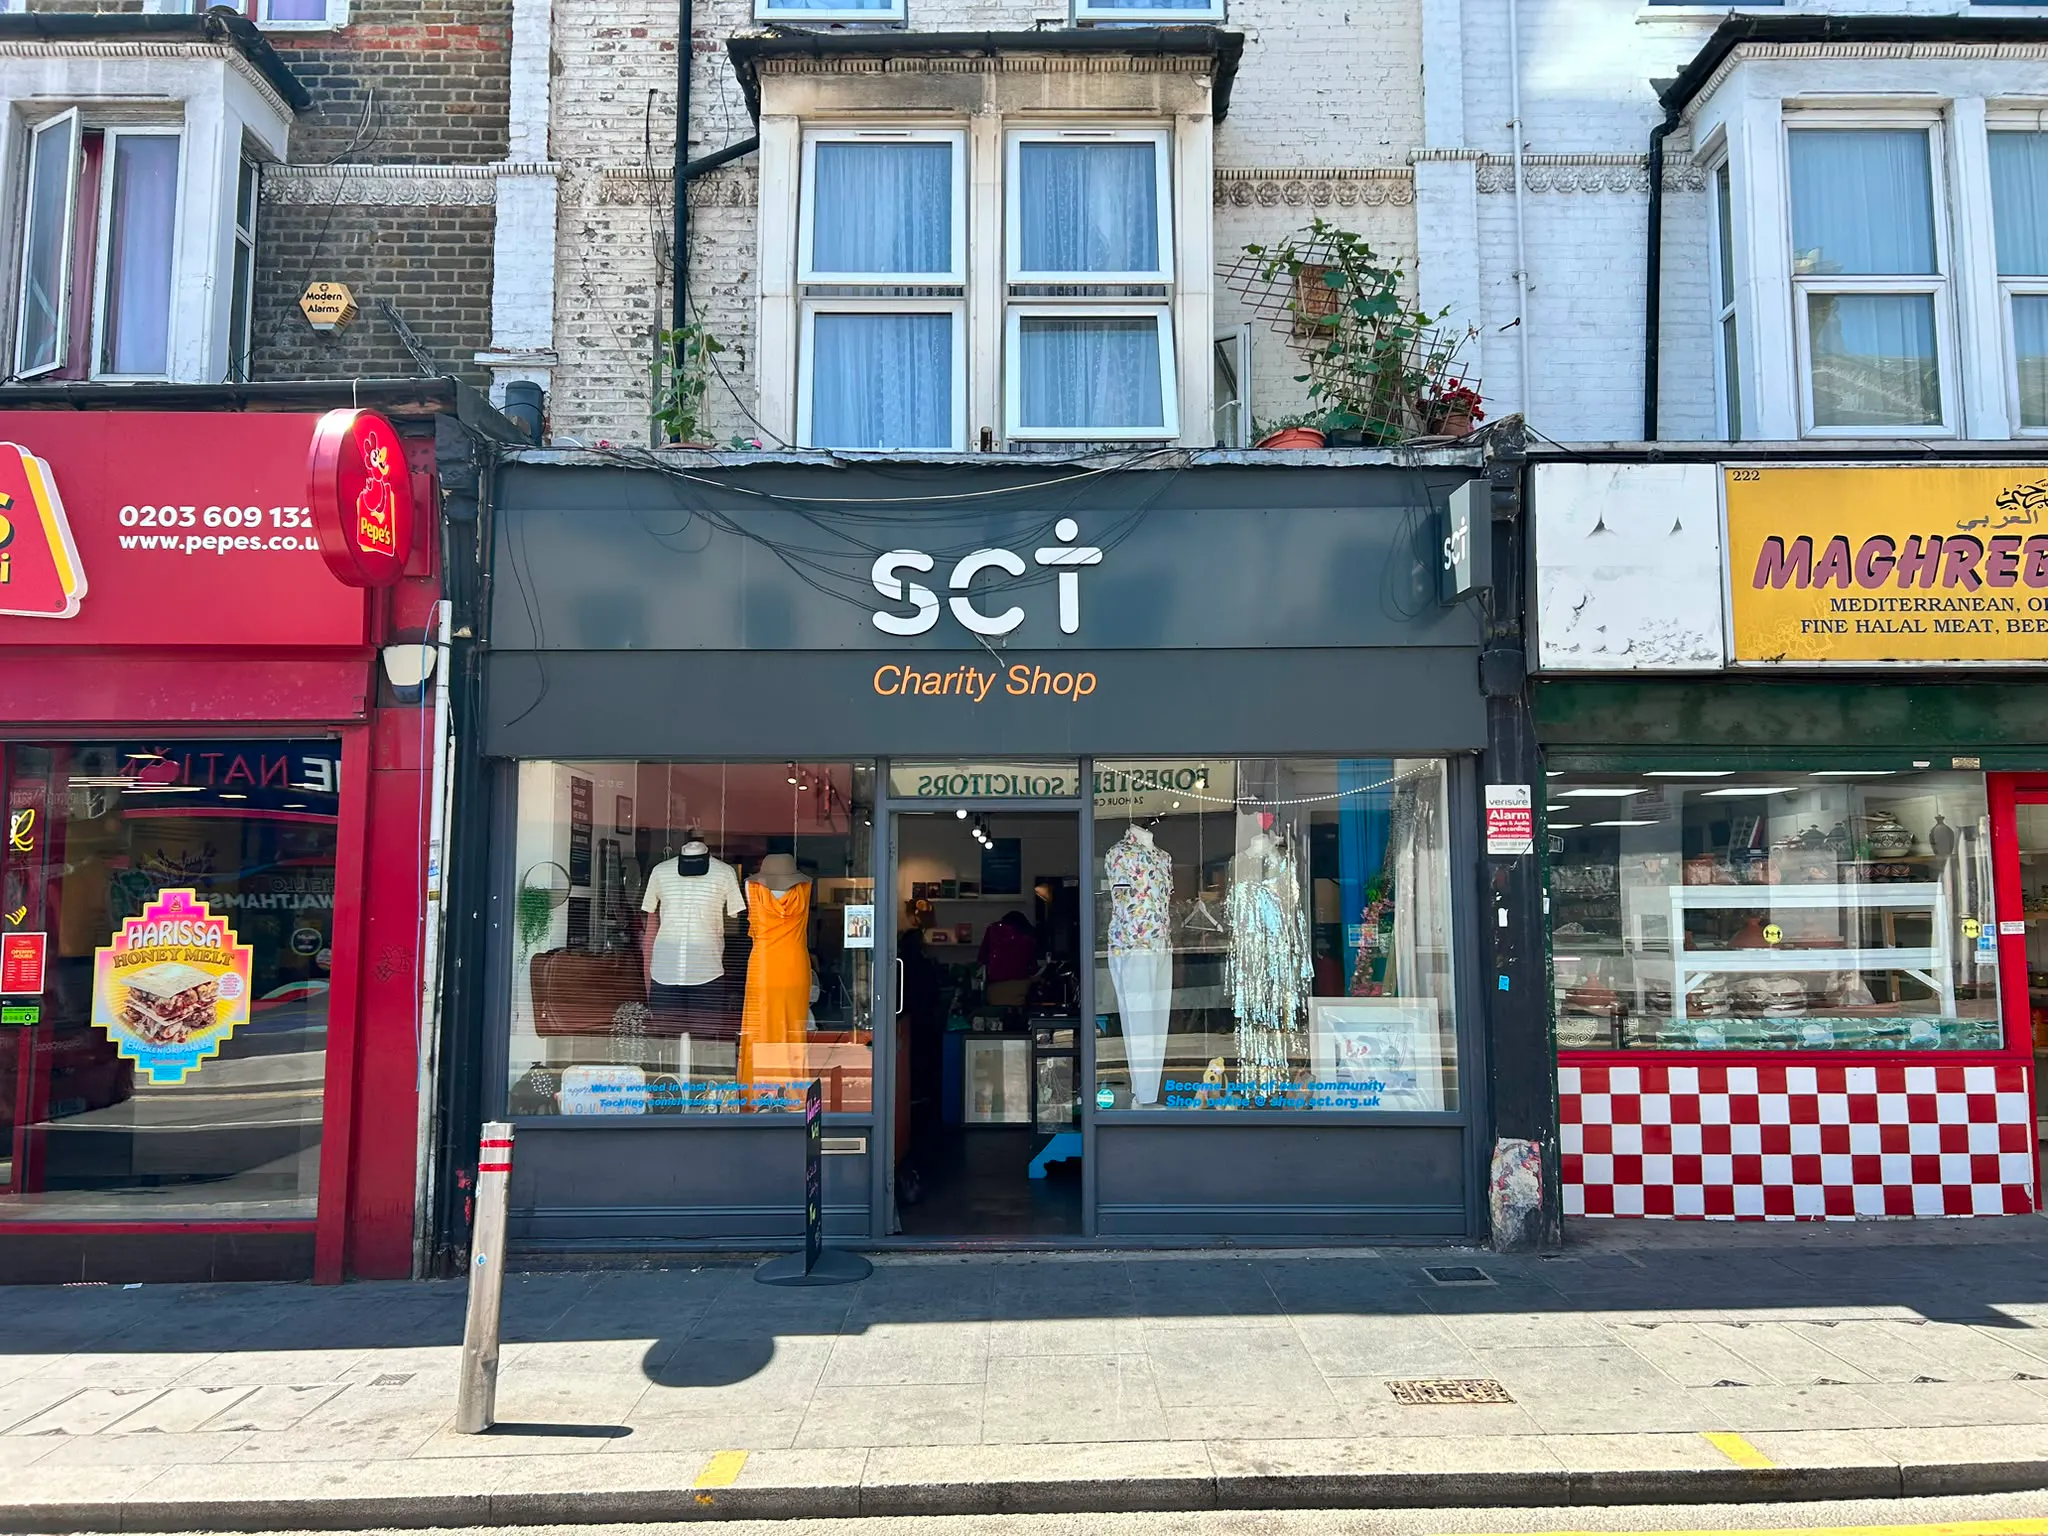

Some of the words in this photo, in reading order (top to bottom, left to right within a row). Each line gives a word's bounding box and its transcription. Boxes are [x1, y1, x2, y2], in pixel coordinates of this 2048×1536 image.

[306, 292, 342, 300] Modern
[1733, 470, 1760, 482] 222
[119, 505, 196, 528] 0203
[203, 506, 262, 528] 609
[360, 516, 391, 545] Pepe's
[1830, 596, 2021, 614] MEDITERRANEAN,
[1801, 619, 1848, 634] FINE
[1856, 619, 1927, 634] HALAL
[1934, 619, 2000, 636] MEAT,
[2007, 619, 2048, 634] BEE
[873, 664, 996, 703] Charity
[1005, 664, 1097, 702] Shop
[1489, 809, 1530, 820] Alarm
[127, 920, 221, 950] HARISSA
[113, 948, 184, 968] HONEY
[184, 948, 235, 966] MELT
[126, 1042, 163, 1054] CHICKEN
[626, 1082, 666, 1093] worked
[669, 1082, 680, 1093] in
[1164, 1079, 1222, 1092] Become
[1226, 1080, 1257, 1093] part
[1261, 1079, 1277, 1091] of
[1307, 1079, 1386, 1093] community
[599, 1098, 645, 1109] Tackling
[1166, 1094, 1202, 1108] Shop
[1206, 1095, 1250, 1107] online
[1269, 1095, 1381, 1109] shop.sct.org.uk
